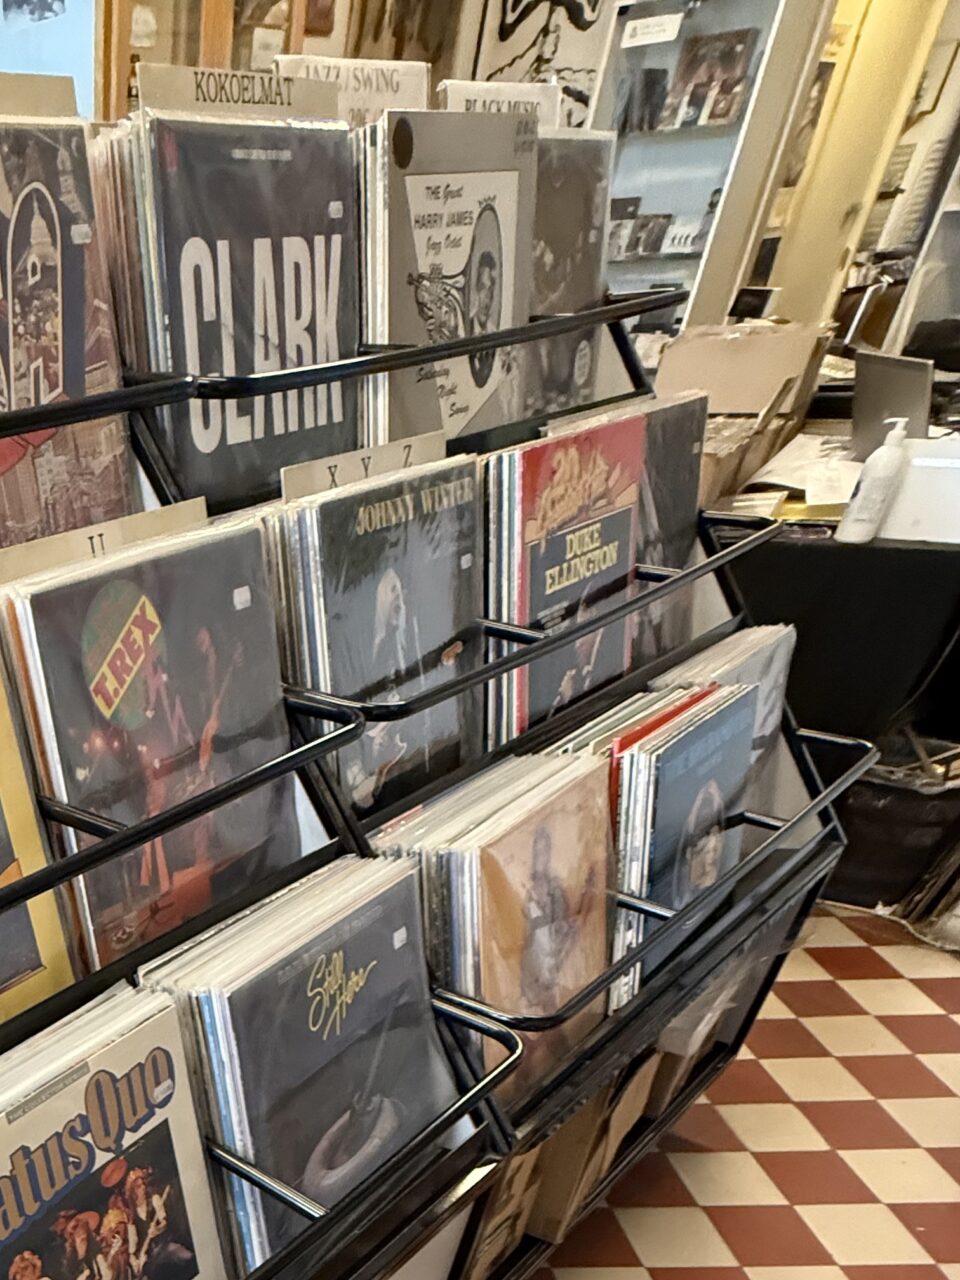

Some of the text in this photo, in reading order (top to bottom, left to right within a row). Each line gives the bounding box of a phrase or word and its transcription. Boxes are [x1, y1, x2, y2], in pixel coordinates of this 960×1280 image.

[194, 71, 295, 106] KOKOELMAT
[414, 209, 474, 230] HARRY JAMES
[180, 234, 343, 454] CLARK
[328, 444, 413, 489] X Y Z
[356, 477, 475, 535] JOHNNY WINTER
[565, 522, 602, 560] DUKE
[545, 541, 619, 595] ELLINGTON
[84, 1046, 176, 1156] Quo
